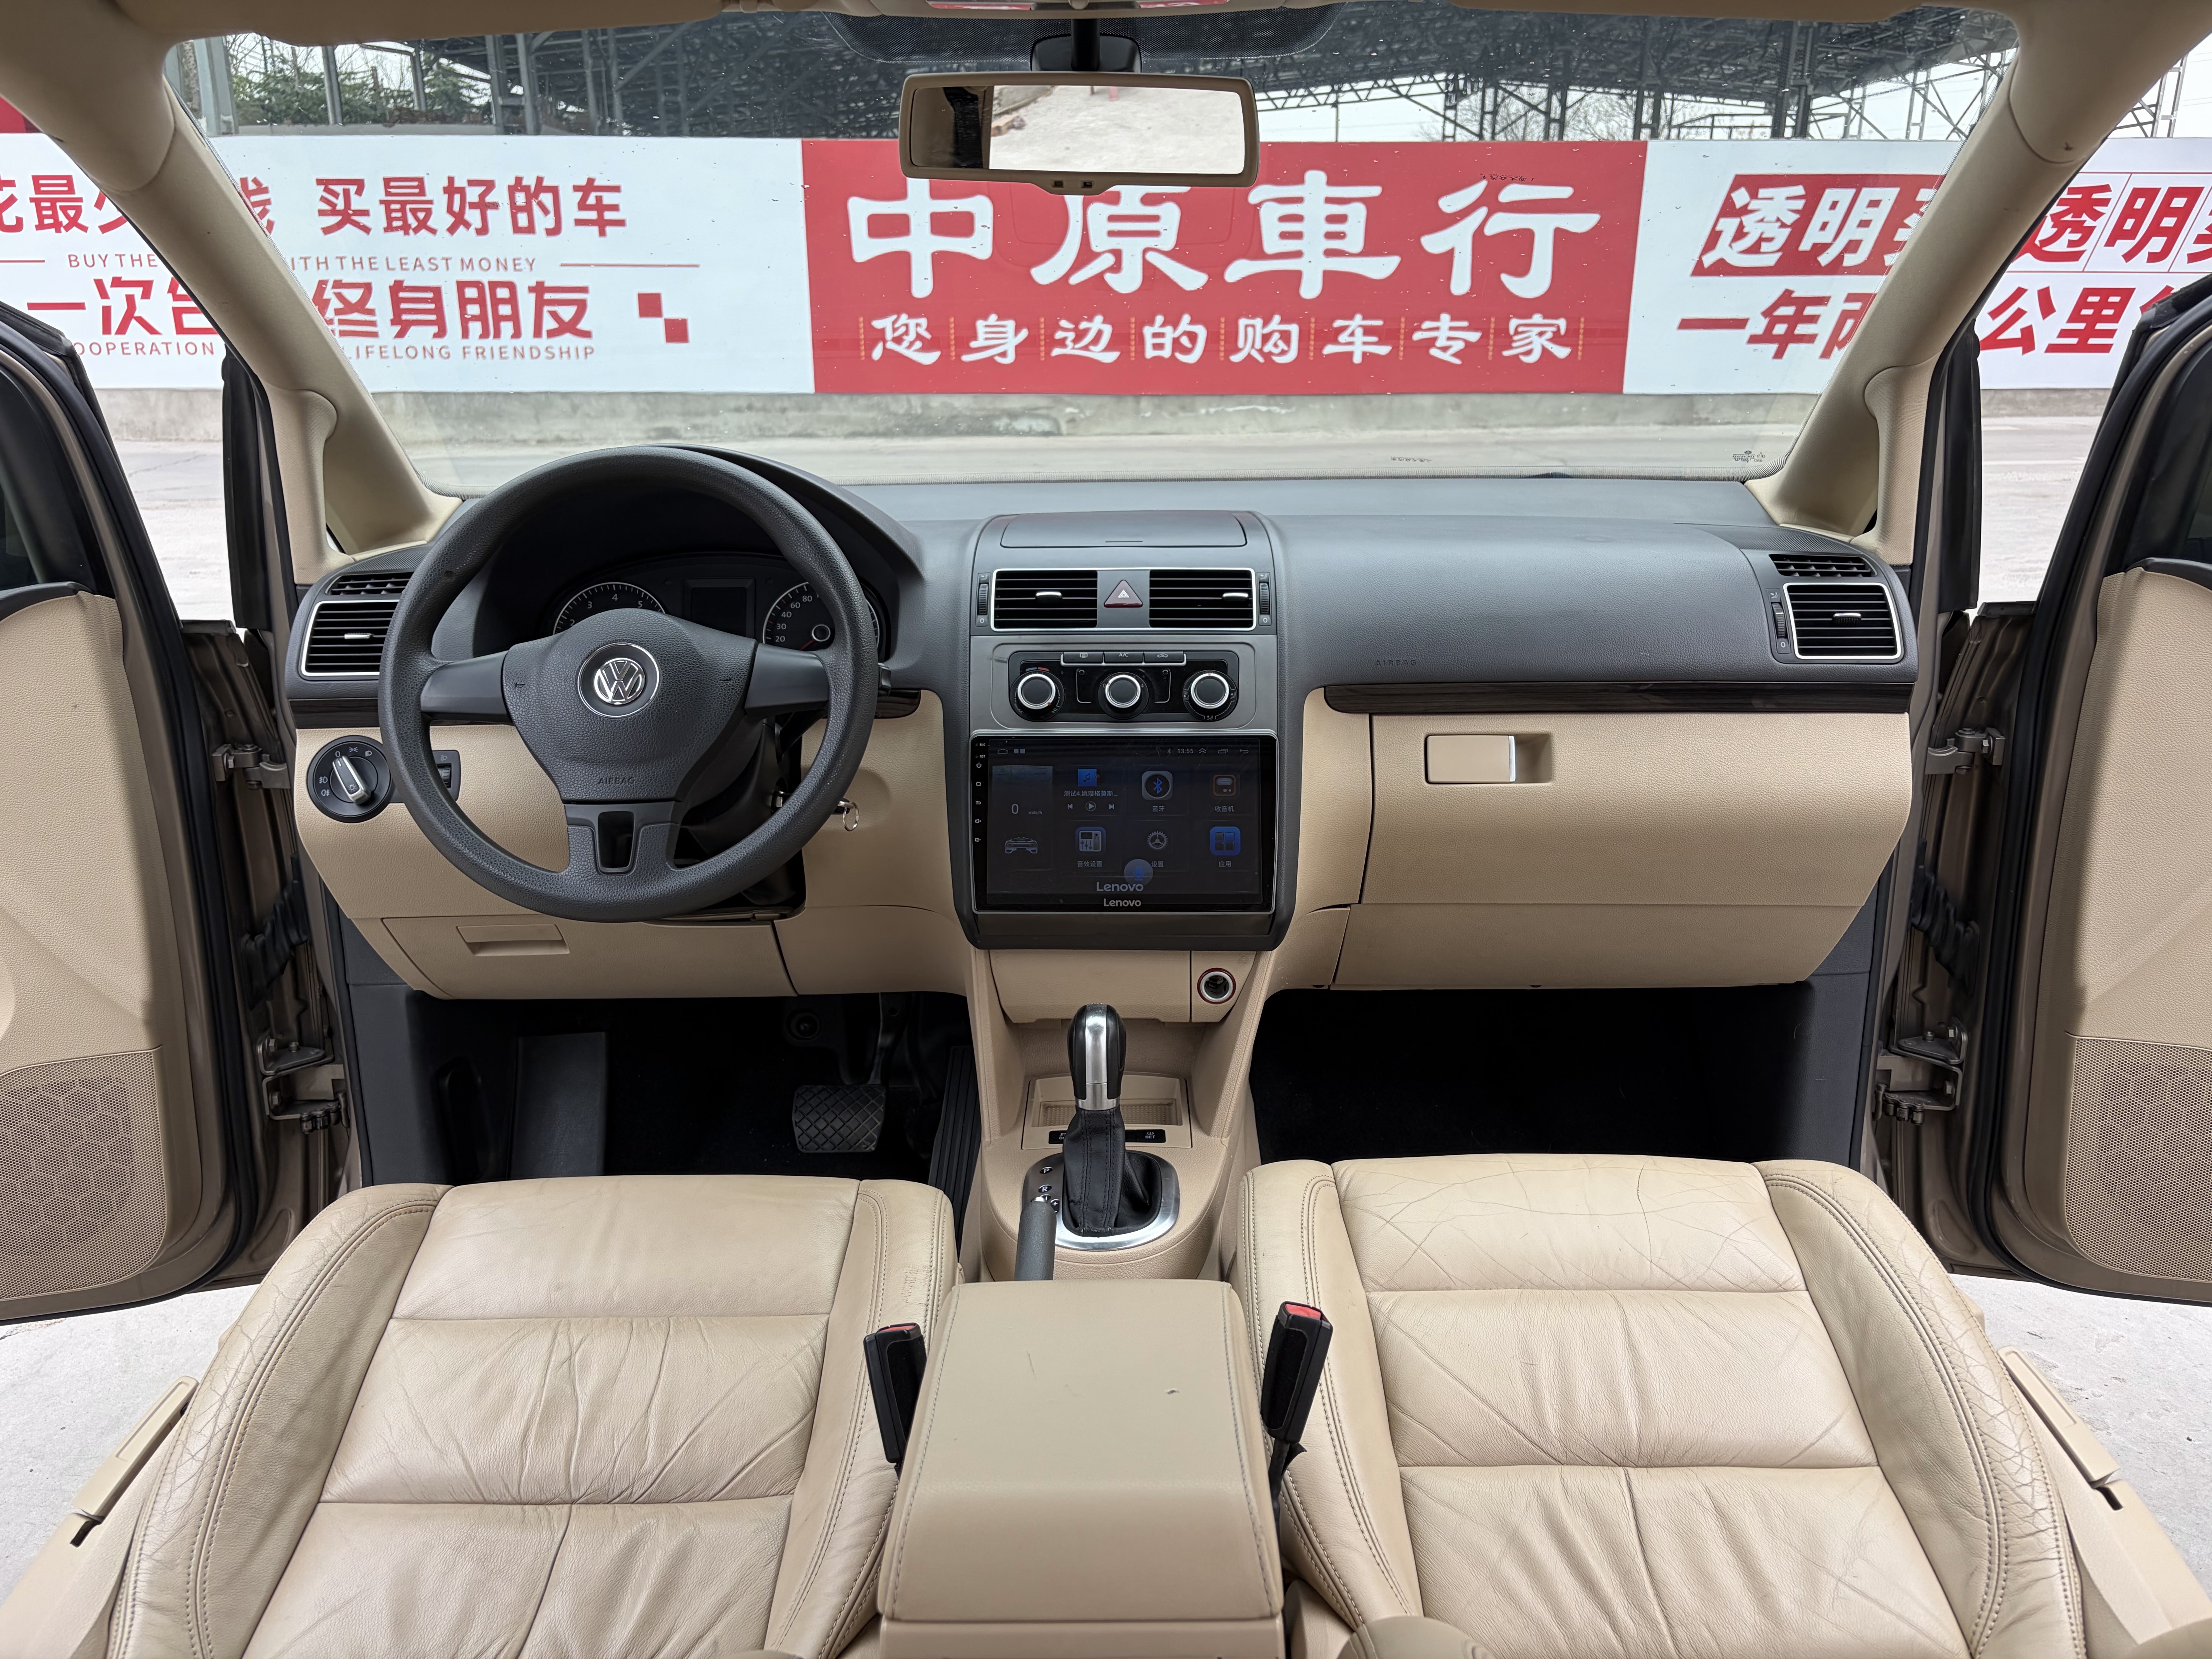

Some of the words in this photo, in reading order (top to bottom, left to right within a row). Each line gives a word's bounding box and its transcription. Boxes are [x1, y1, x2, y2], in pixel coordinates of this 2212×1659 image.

[315, 174, 627, 237] 买最好的车
[847, 170, 1601, 299] 中原車行
[68, 254, 108, 268] BUY
[115, 254, 158, 267] THE
[291, 256, 329, 271] ITH
[335, 256, 379, 271] THE
[386, 256, 453, 271] LEAST
[460, 256, 536, 272] MONEY
[312, 278, 593, 340] 终身朋友
[1980, 285, 2175, 356] 公里
[871, 313, 1571, 365] 您身边的购车专家
[73, 342, 214, 356] OOPERATION
[343, 345, 451, 359] IFELONG
[462, 345, 595, 360] FRIENDSHIP
[587, 601, 592, 609] 3
[1012, 804, 1019, 814] 0
[1096, 881, 1144, 892] Lenovo
[1103, 898, 1142, 907] Lenovo
